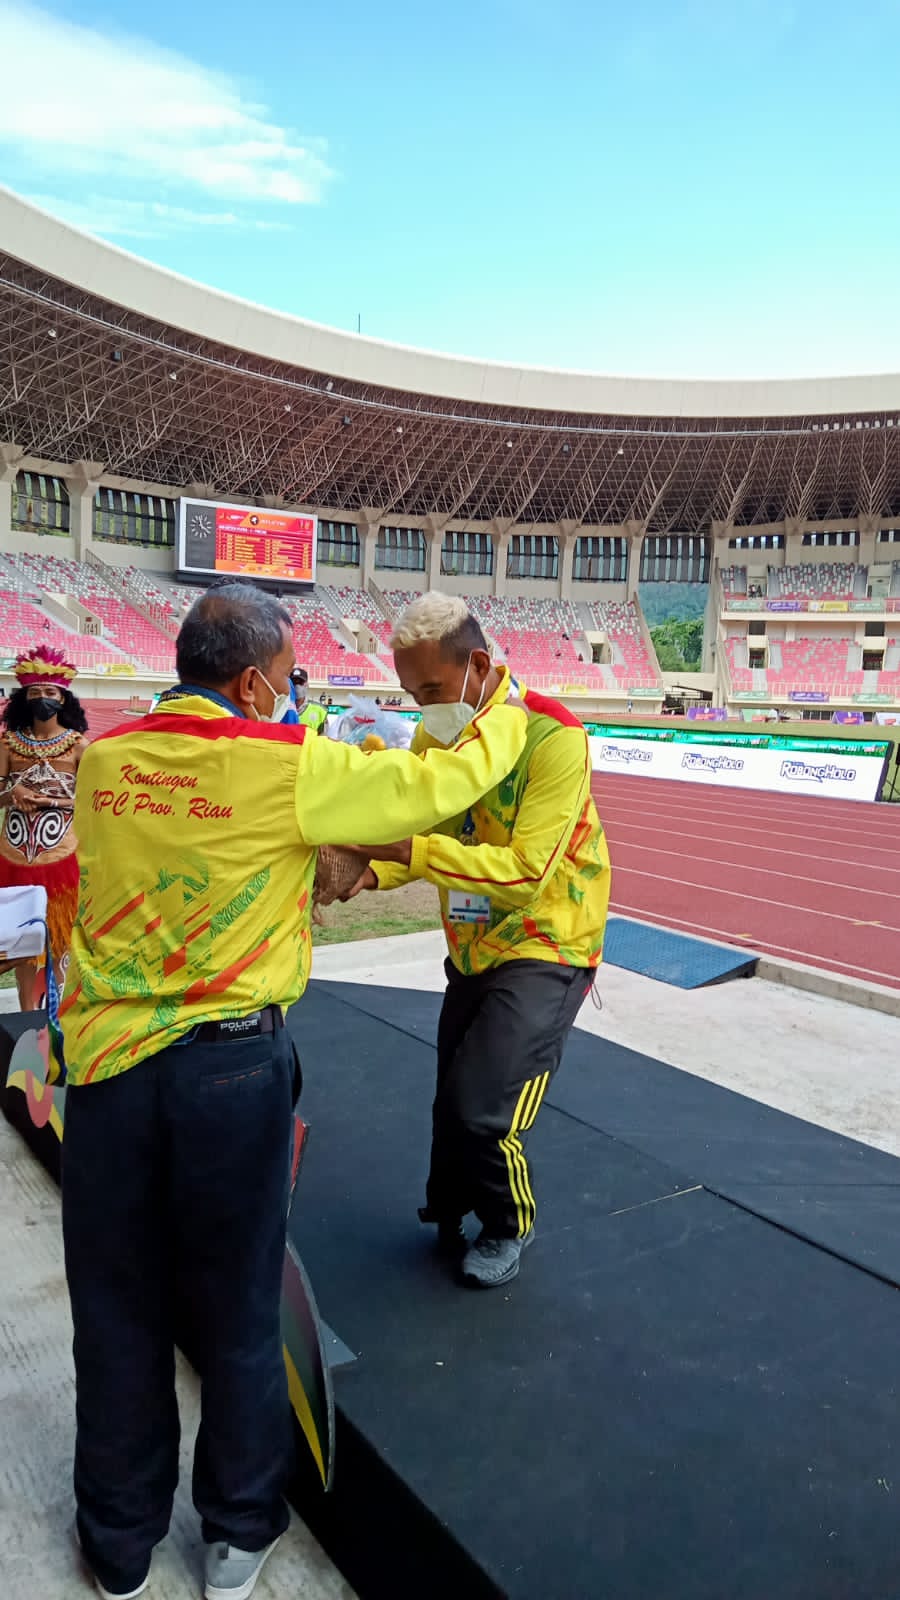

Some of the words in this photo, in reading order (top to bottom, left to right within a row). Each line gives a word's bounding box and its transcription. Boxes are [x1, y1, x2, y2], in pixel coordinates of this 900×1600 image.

[119, 764, 198, 794] Kontingen
[92, 789, 130, 816] NPC
[133, 793, 176, 816] Prov.
[187, 797, 233, 819] Riau
[220, 1019, 258, 1030] POLICE
